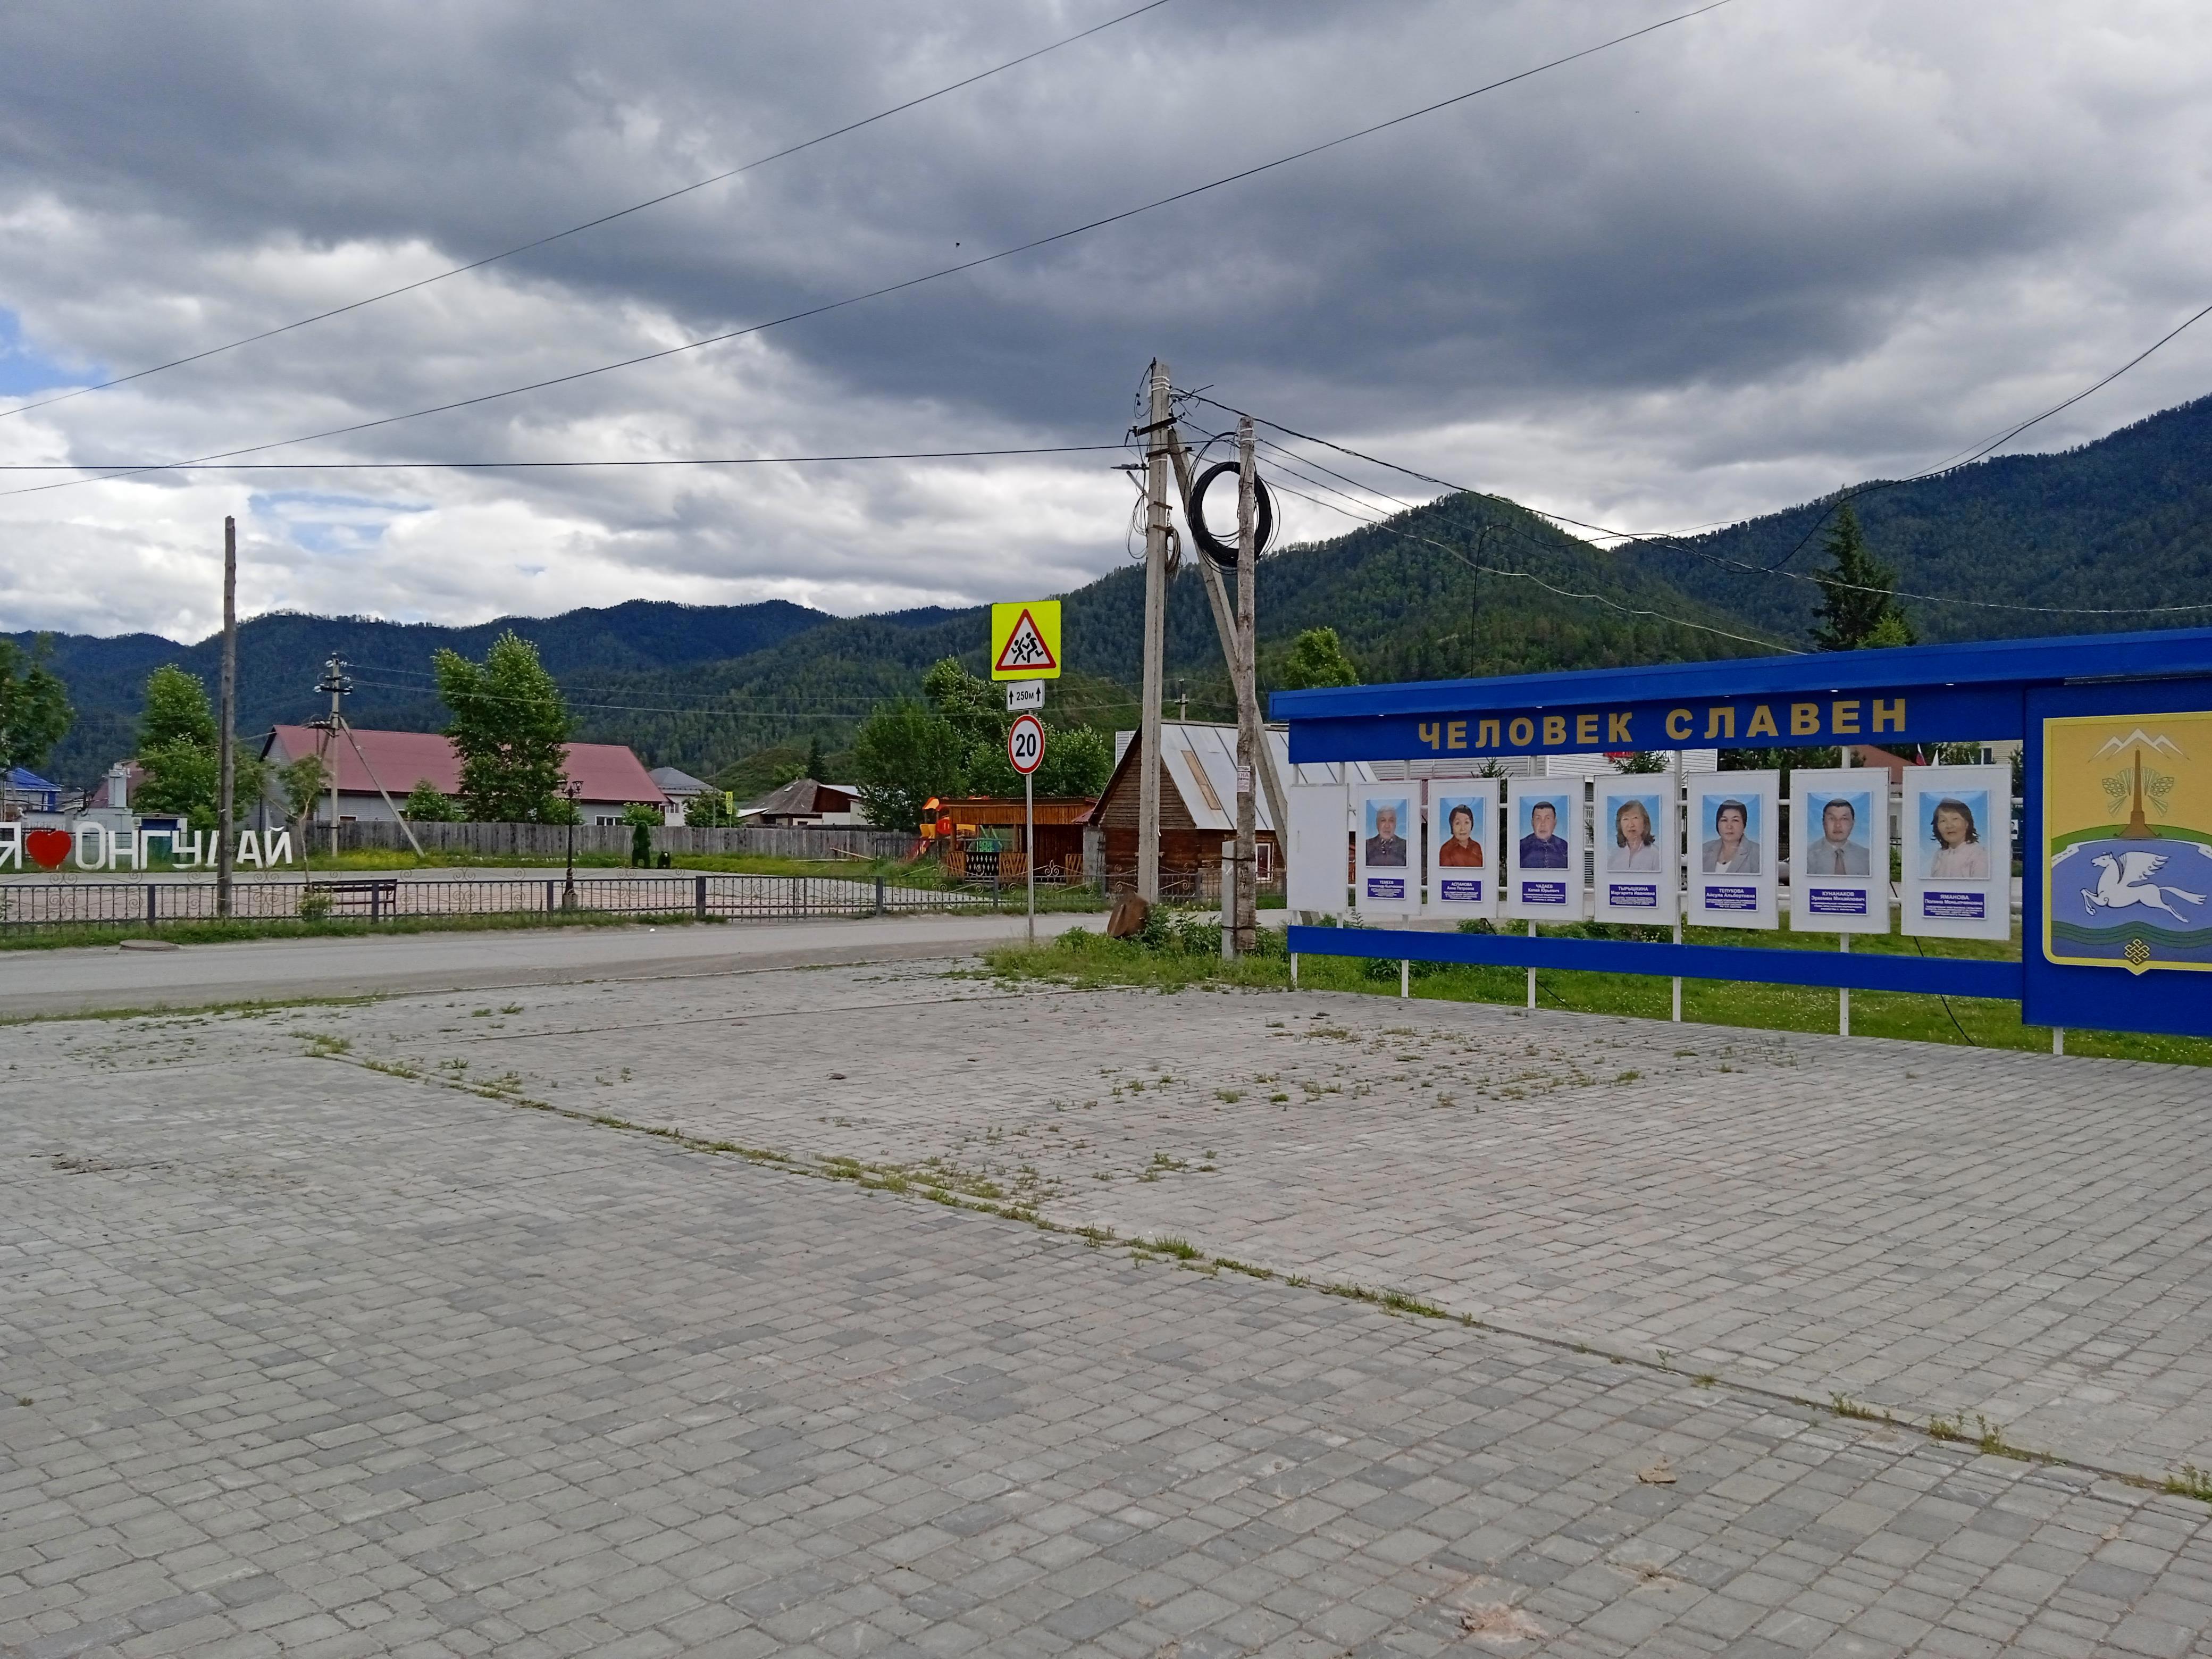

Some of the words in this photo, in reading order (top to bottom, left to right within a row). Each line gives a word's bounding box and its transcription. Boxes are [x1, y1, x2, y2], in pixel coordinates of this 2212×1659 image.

[1015, 733, 1036, 757] 20
[1419, 712, 1632, 750] ЧЕЛОВЕК
[1665, 698, 1906, 740] СЛАВЕН
[0, 822, 22, 869] Я
